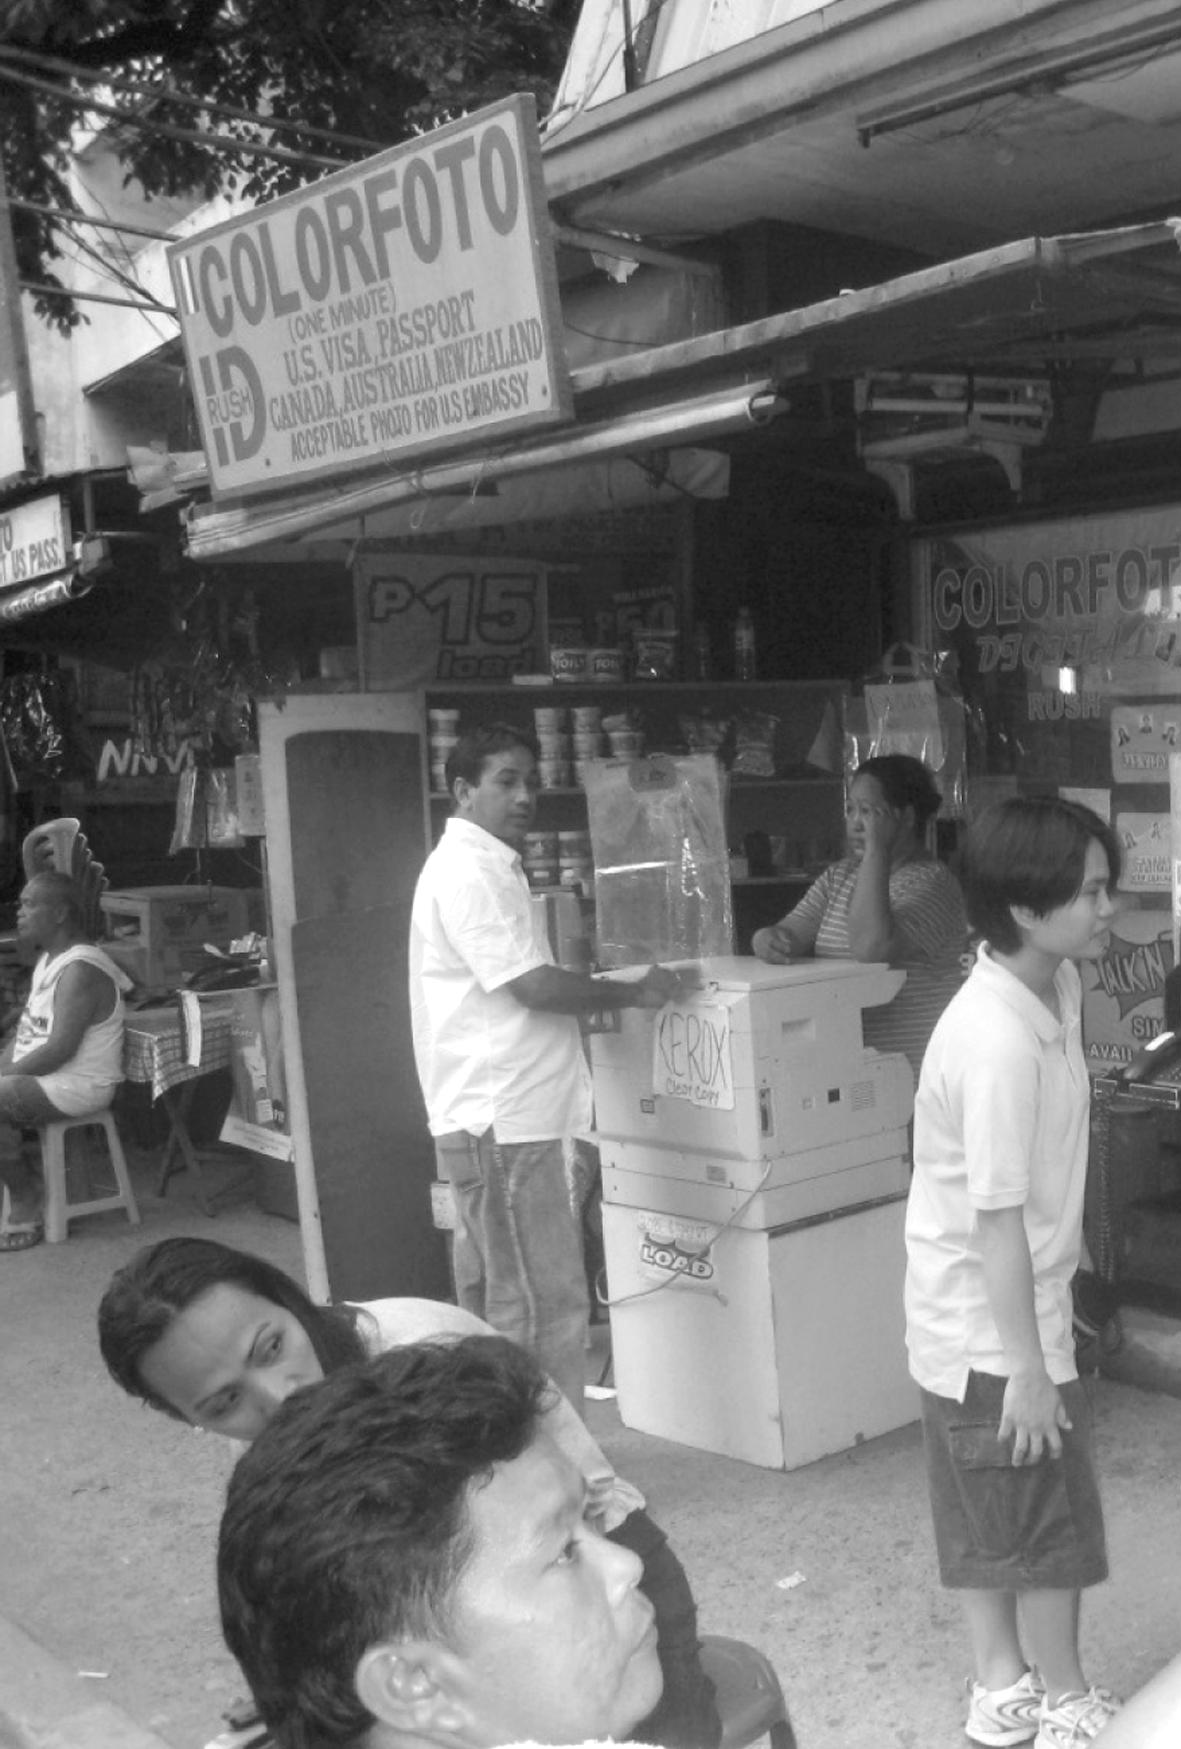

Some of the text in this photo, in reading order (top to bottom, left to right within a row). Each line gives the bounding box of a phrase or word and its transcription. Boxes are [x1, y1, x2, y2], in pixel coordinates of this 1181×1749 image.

[200, 124, 519, 338] COLORFOTO
[328, 280, 397, 330] MINUTE)
[375, 288, 476, 359] PASSPORT
[207, 388, 255, 425] RUSH
[291, 414, 369, 462] ACCEPTABLE
[370, 404, 412, 443] PHOTO
[414, 396, 440, 433] FOR
[463, 370, 530, 420] EMBASSY
[1028, 690, 1101, 721] RUSH
[640, 1244, 715, 1281] LOAD
